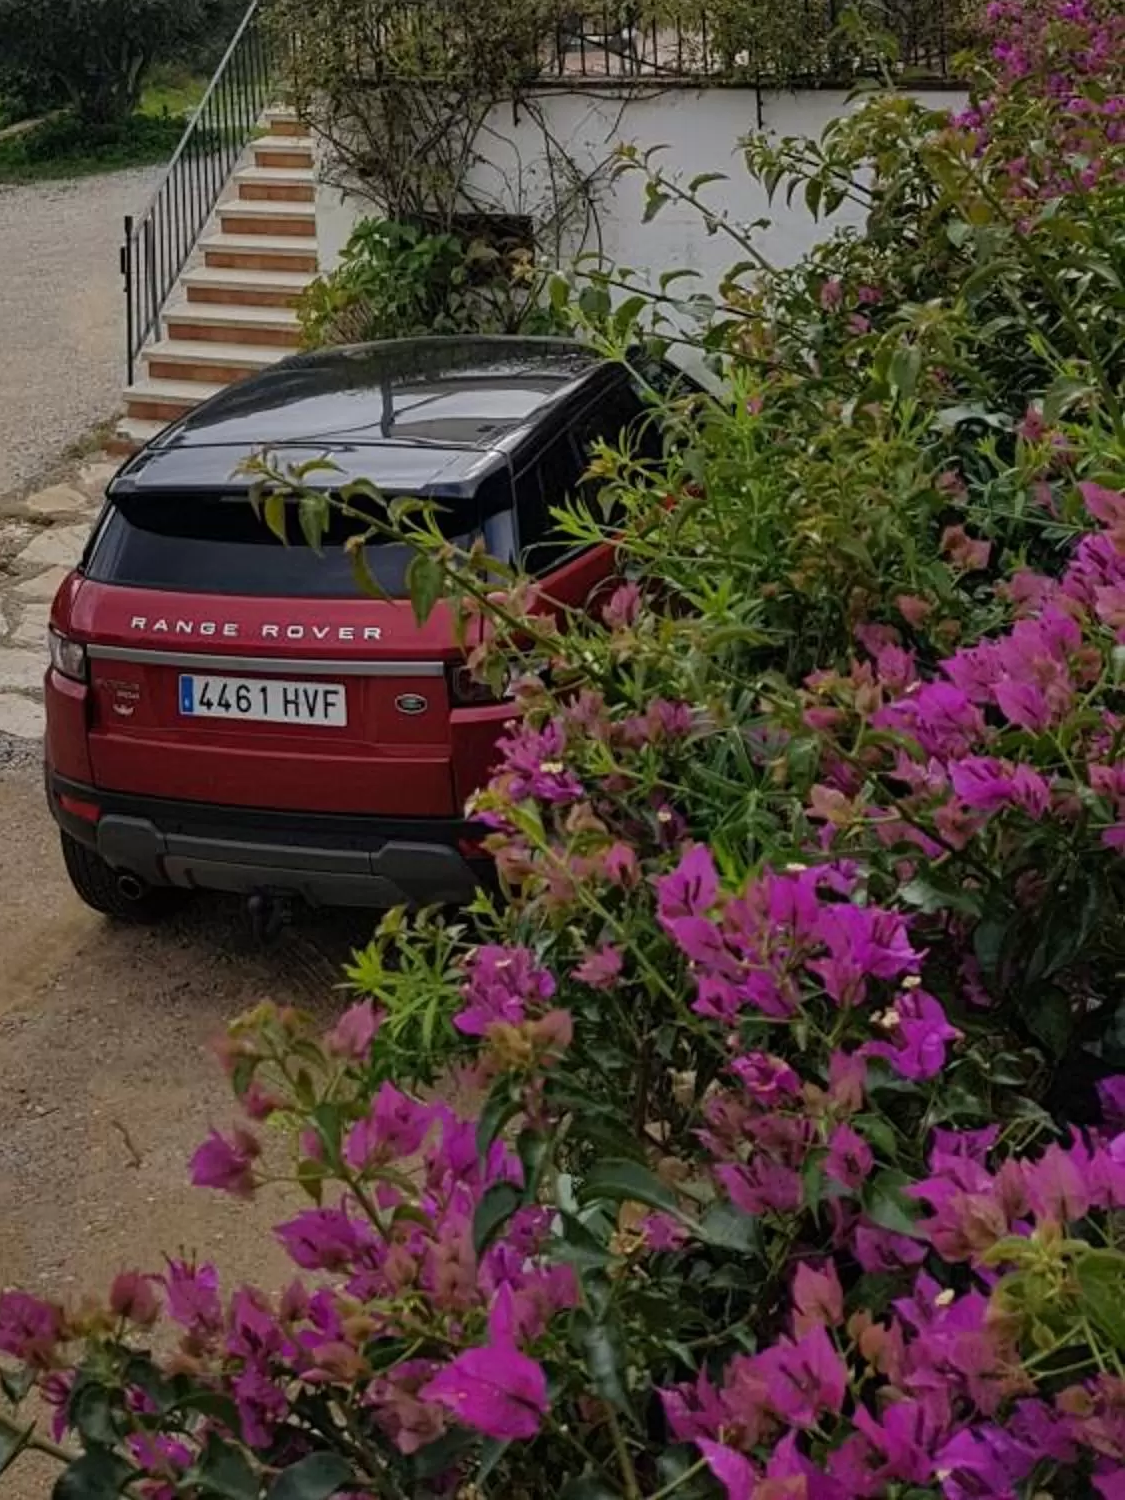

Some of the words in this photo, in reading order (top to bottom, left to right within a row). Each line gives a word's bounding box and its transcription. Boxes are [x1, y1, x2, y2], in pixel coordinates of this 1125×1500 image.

[131, 616, 239, 637] RANGE
[262, 624, 382, 640] ROVER
[199, 681, 268, 715] 4461
[282, 687, 340, 719] HVF
